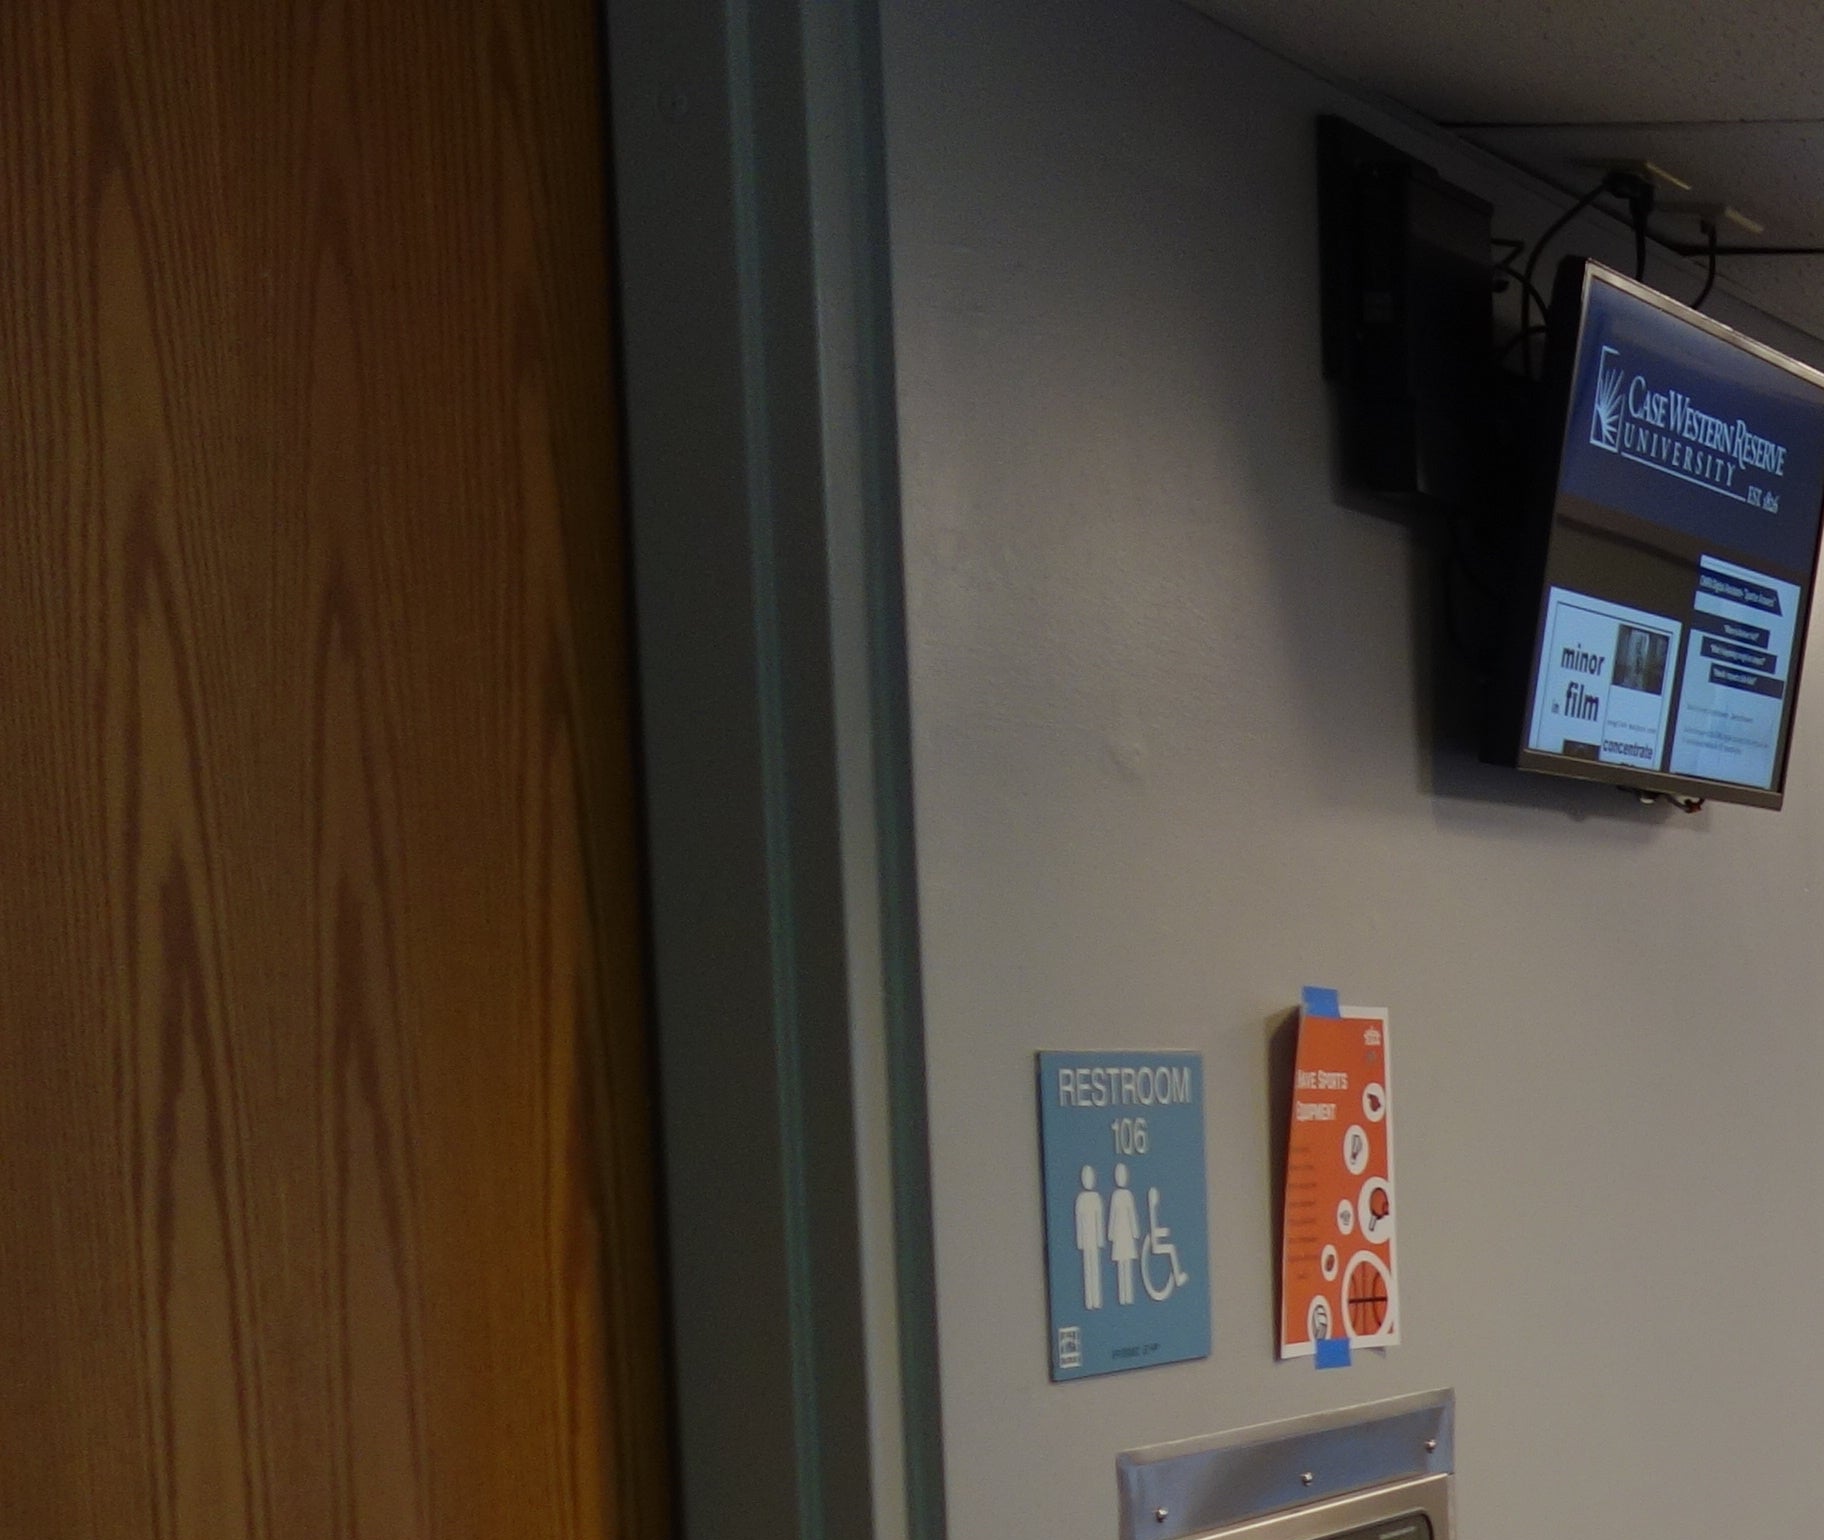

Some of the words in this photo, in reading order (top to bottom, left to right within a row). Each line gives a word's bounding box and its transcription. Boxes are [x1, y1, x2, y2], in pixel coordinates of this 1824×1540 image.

[1629, 376, 1668, 428] CASE
[1669, 390, 1735, 455] WESTERN
[1733, 419, 1787, 476] RESERVE
[1624, 422, 1736, 487] UNIVERSITY
[1561, 643, 1605, 677] minor
[1564, 681, 1600, 721] film
[1602, 739, 1653, 760] concentrate
[1058, 1065, 1191, 1107] RESTROOM
[1111, 1117, 1149, 1155] 106
